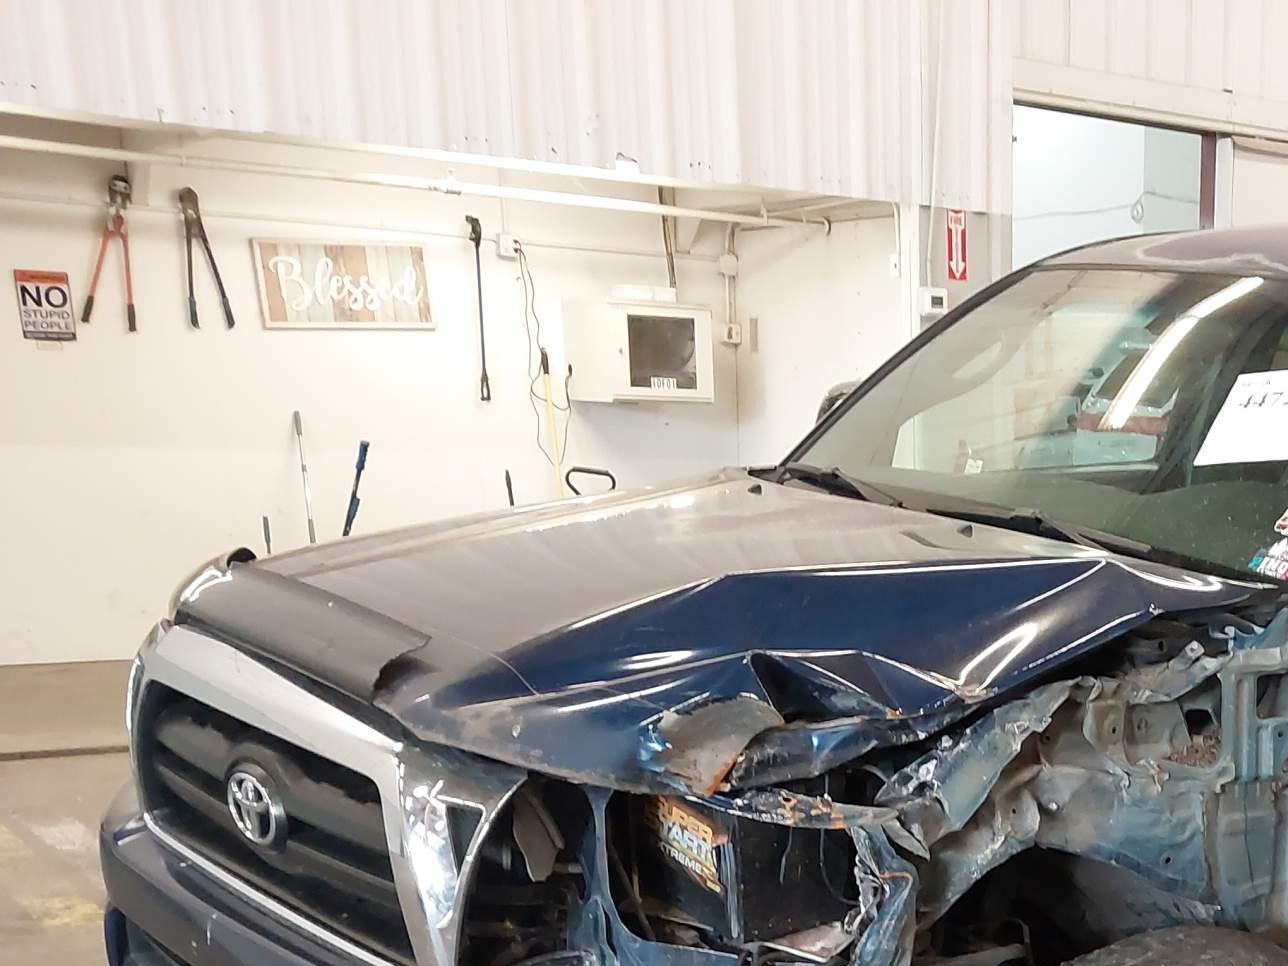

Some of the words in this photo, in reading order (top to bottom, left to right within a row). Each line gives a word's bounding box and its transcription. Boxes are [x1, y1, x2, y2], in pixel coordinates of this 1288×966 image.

[268, 254, 424, 312] Blessed
[20, 285, 68, 309] NO
[23, 309, 70, 321] STUPID
[24, 320, 71, 331] PEOPLE
